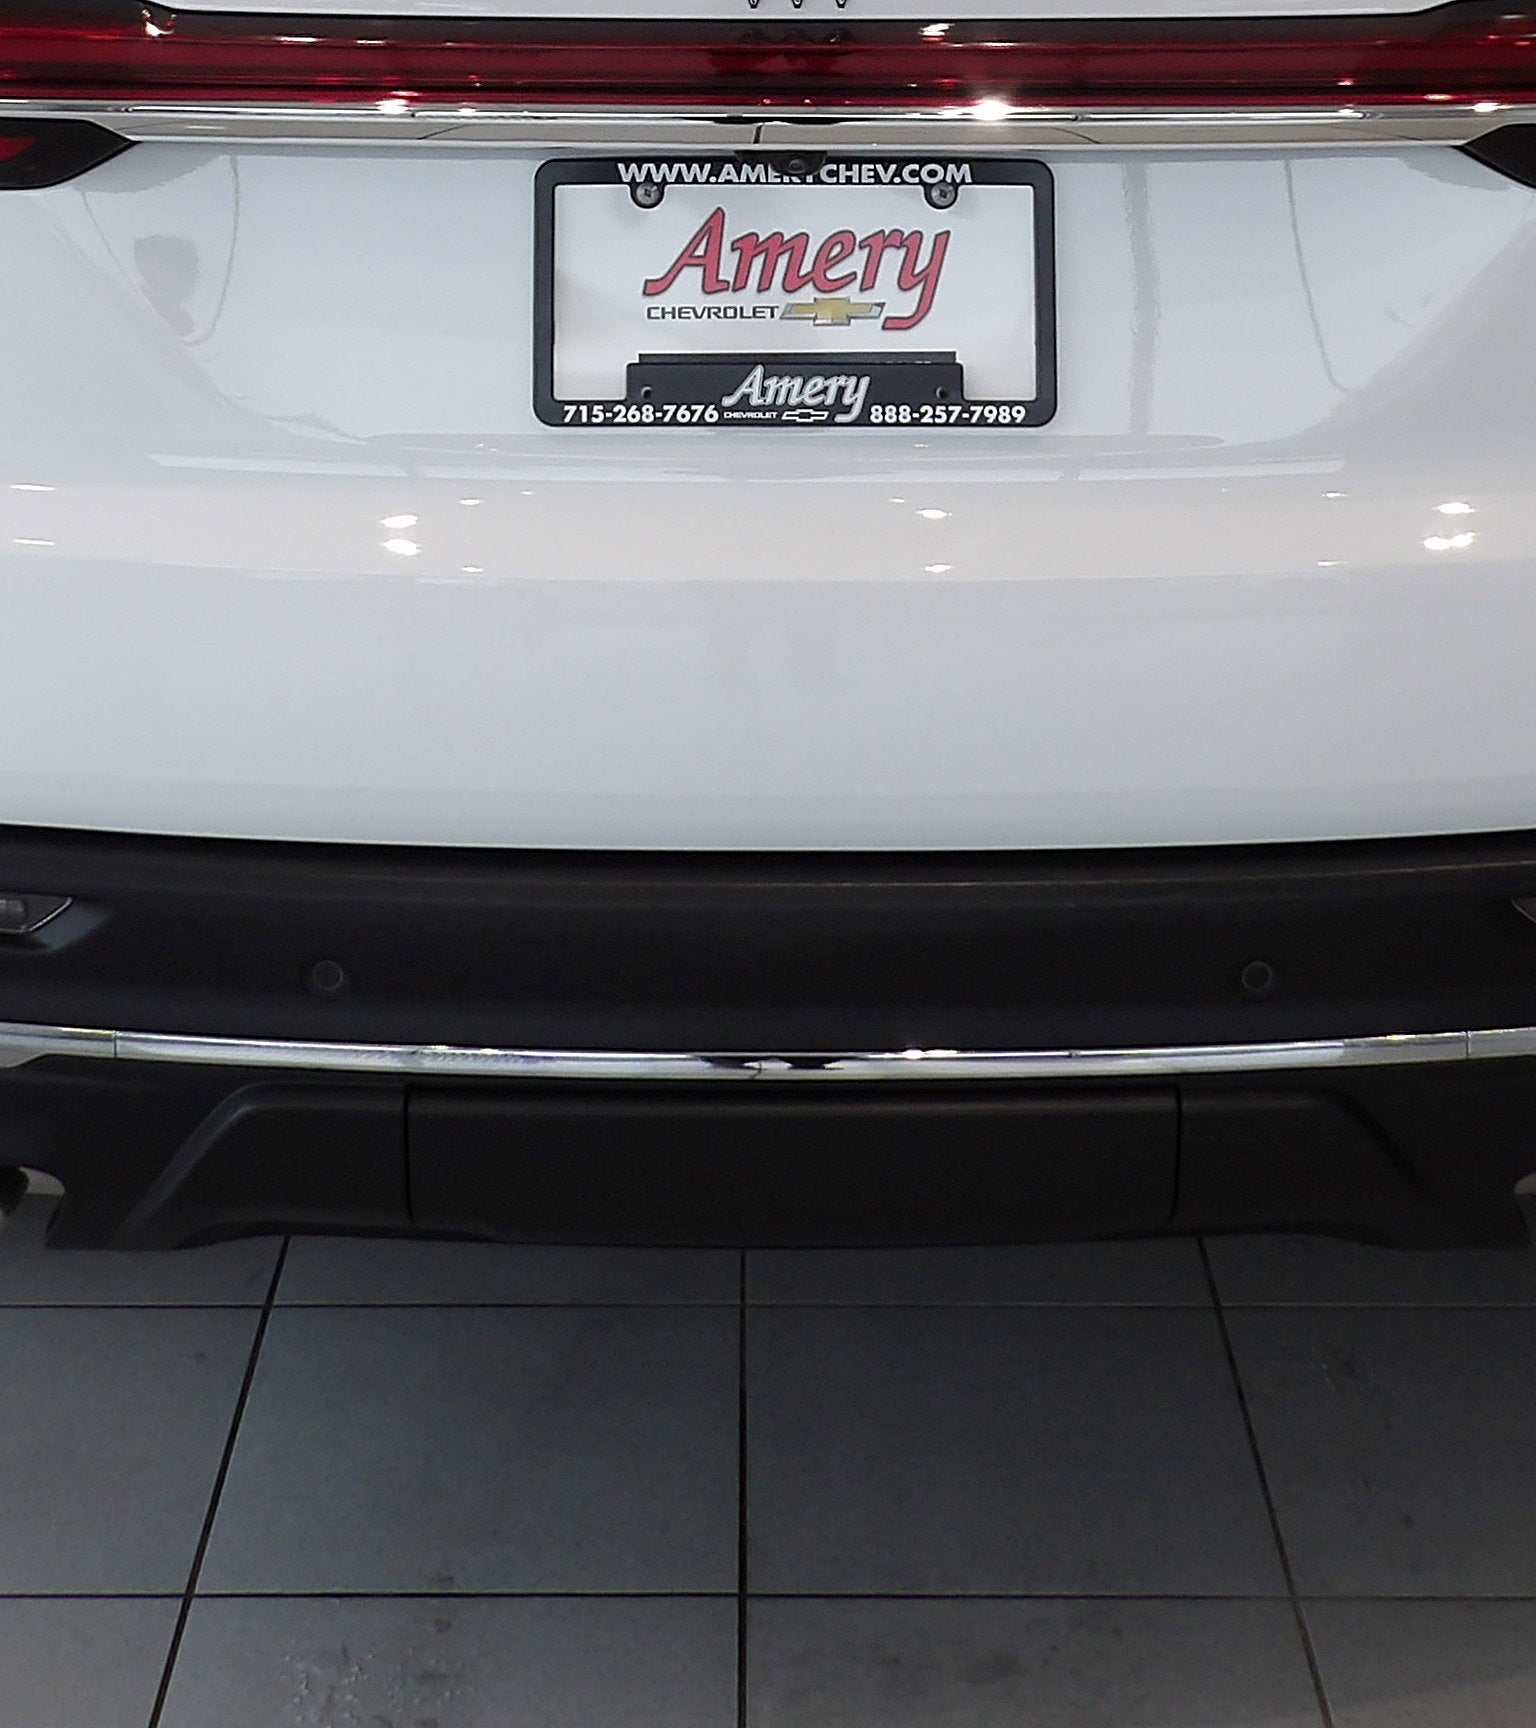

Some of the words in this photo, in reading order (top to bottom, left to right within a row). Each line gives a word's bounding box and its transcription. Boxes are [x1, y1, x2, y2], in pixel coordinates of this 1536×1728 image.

[642, 206, 952, 331] Amery
[646, 304, 780, 320] CHEVROLET
[721, 364, 871, 423] Amery
[564, 403, 719, 423] 715-268-7676
[723, 410, 778, 420] CHEVROLET
[869, 404, 1026, 424] 888-257-7989
